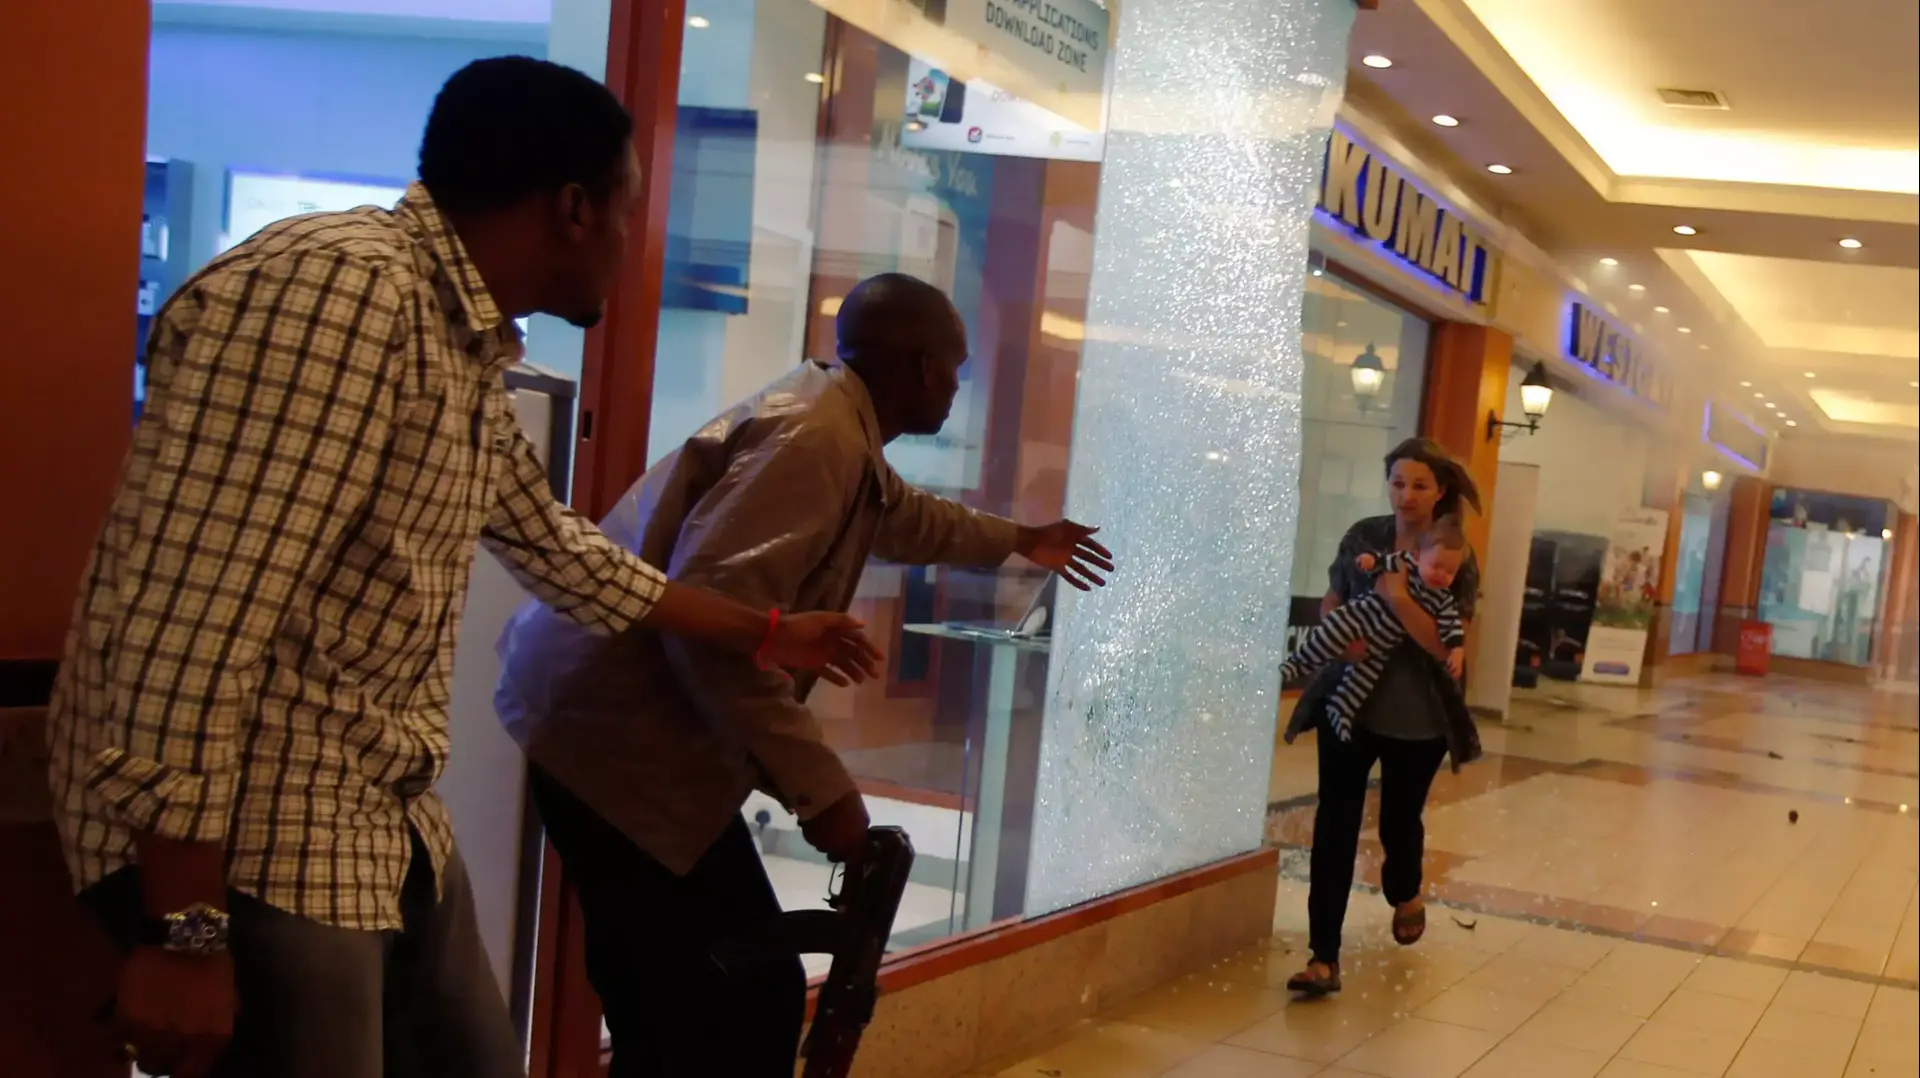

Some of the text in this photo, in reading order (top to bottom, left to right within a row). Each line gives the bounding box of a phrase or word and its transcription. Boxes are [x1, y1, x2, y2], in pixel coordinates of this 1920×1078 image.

[985, 1, 1088, 73] DOWNLOAD ZONE
[1008, 0, 1098, 50] PLICATIONS
